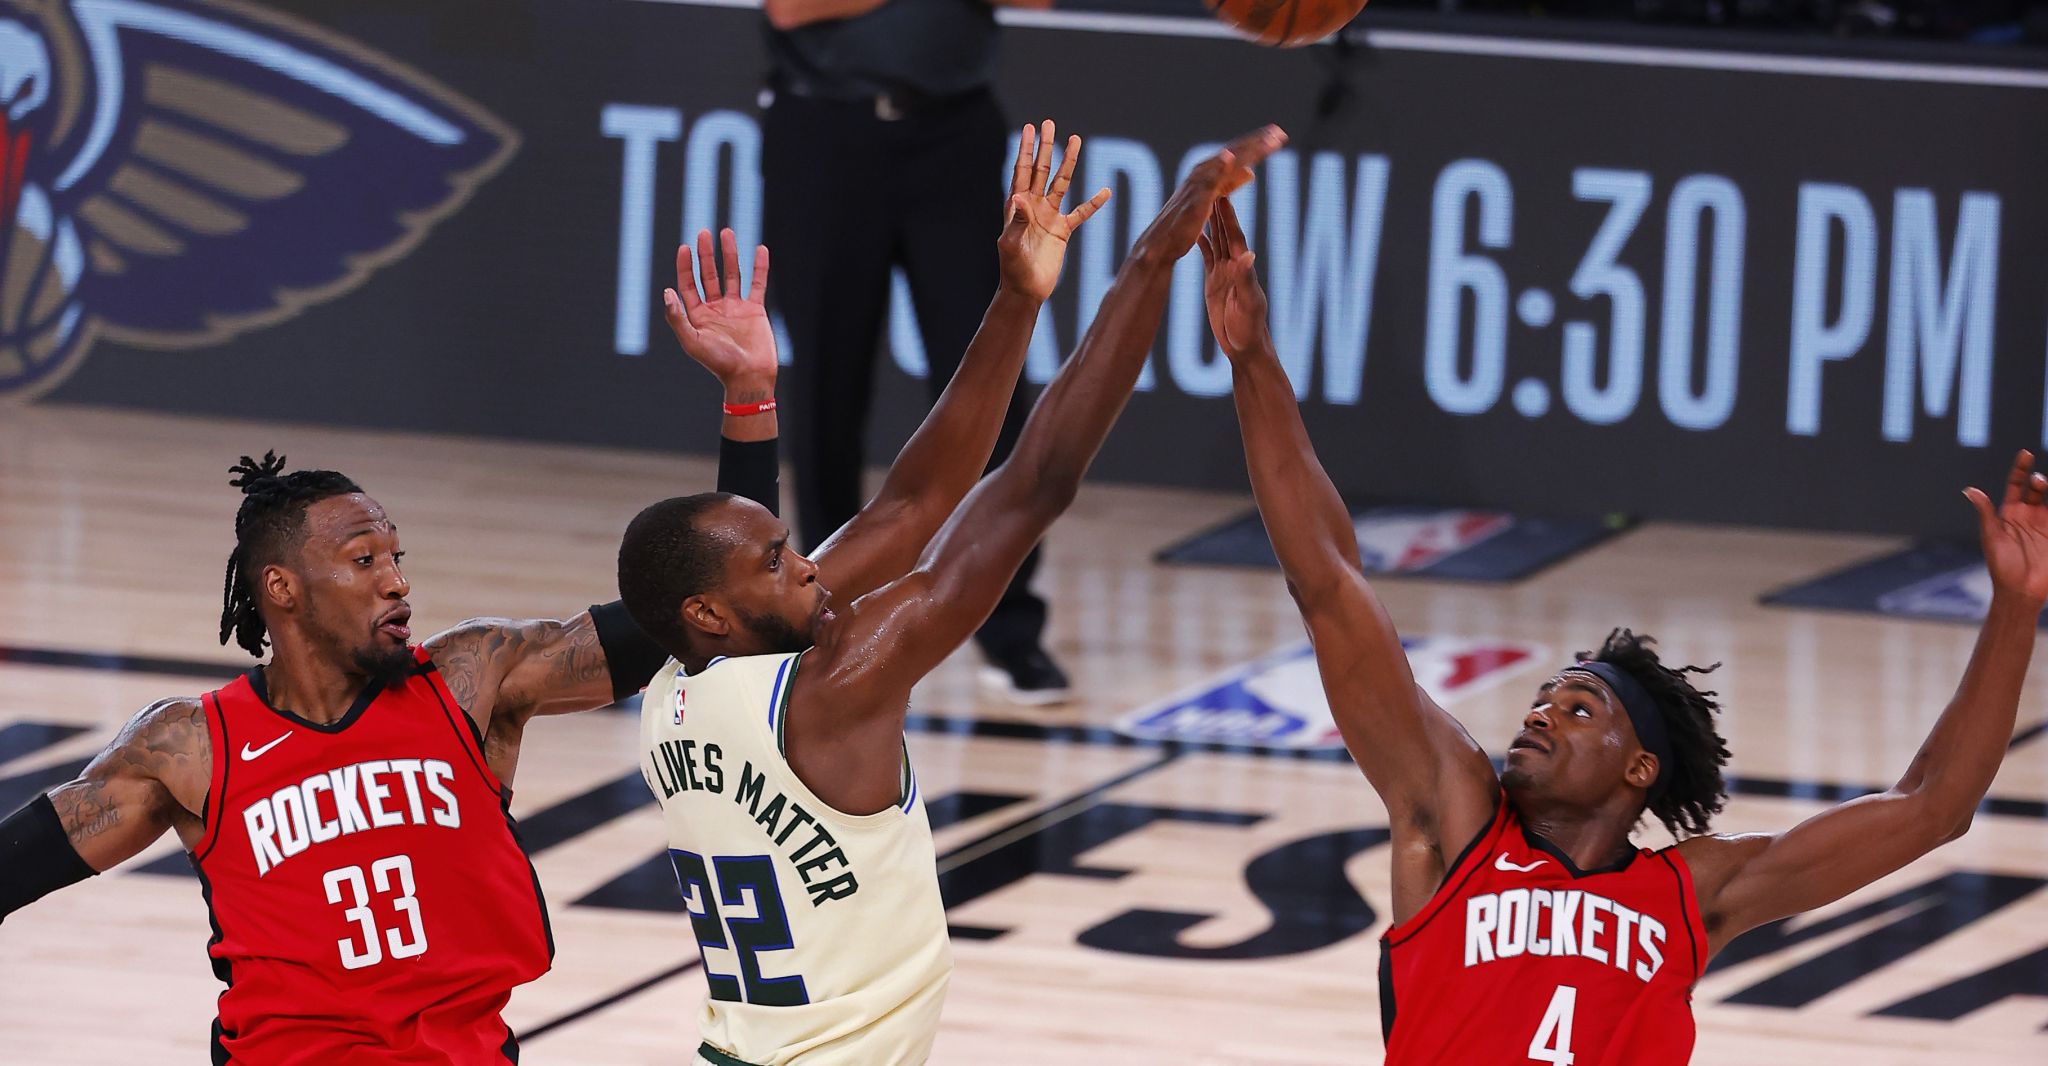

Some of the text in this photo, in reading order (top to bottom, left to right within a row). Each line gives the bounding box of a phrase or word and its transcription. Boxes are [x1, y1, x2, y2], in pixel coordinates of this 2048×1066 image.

[601, 103, 1391, 405] TOROW
[1424, 157, 1748, 432] 6:30
[1786, 181, 2001, 448] PM
[242, 758, 461, 878] ROCKETS
[650, 739, 724, 799] LIVES
[734, 760, 859, 907] MATTER
[322, 854, 428, 970] 33
[668, 847, 810, 1007] 22
[1464, 887, 1666, 983] ROCKETS
[1527, 984, 1578, 1066] 4
